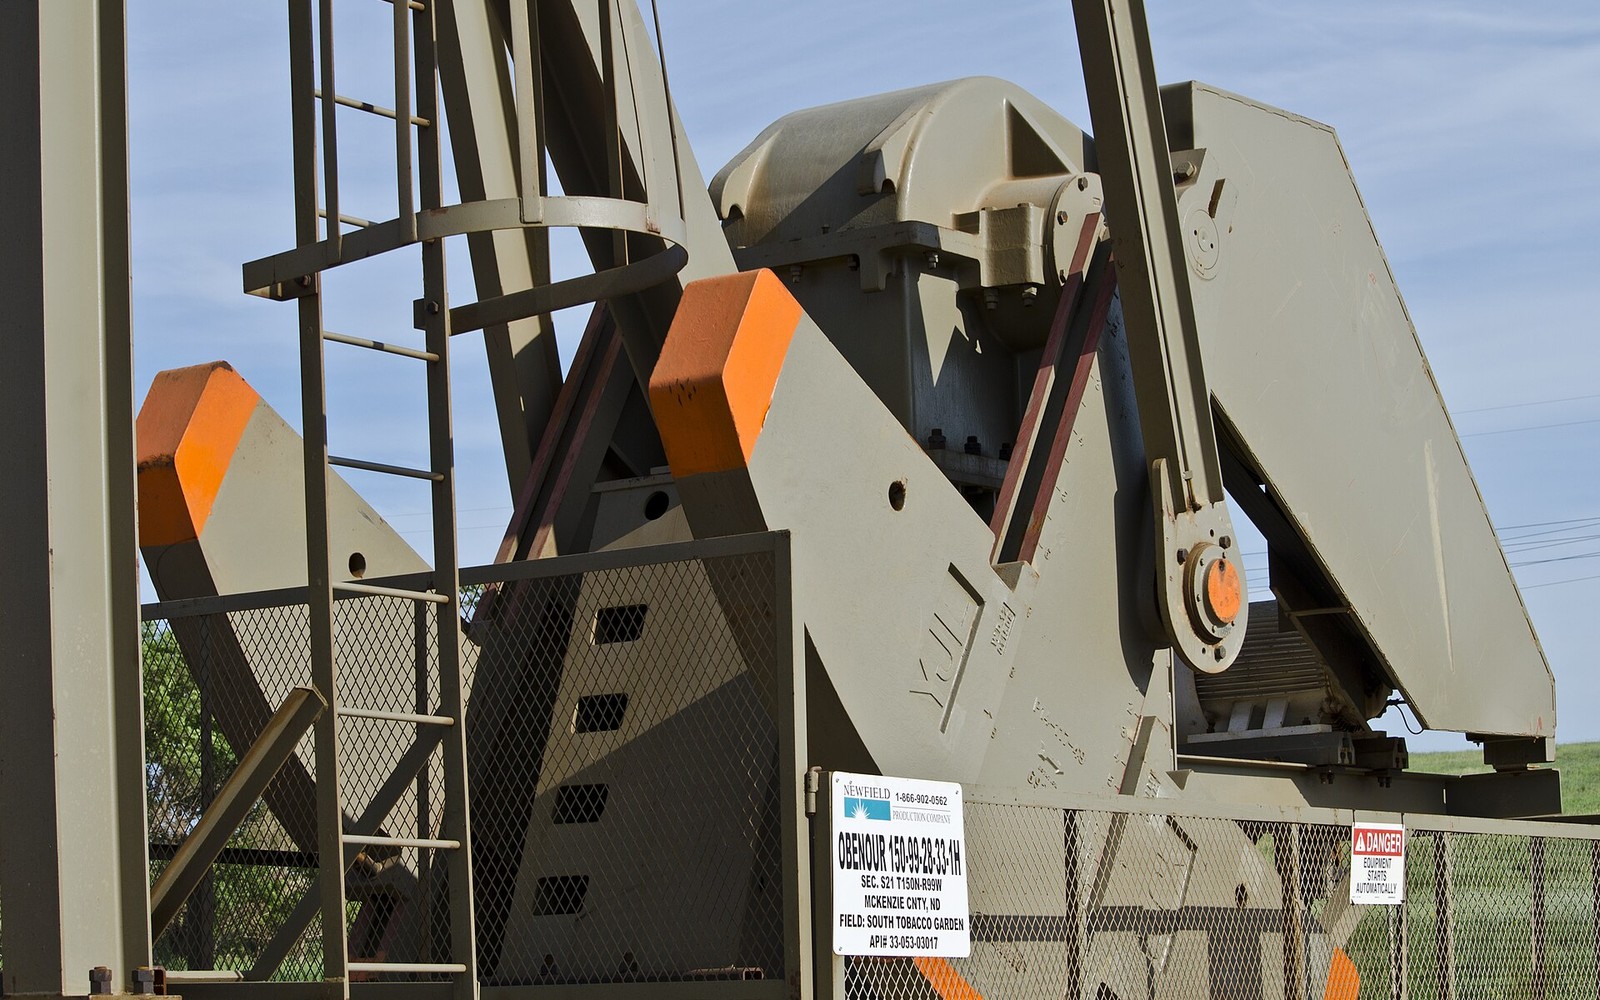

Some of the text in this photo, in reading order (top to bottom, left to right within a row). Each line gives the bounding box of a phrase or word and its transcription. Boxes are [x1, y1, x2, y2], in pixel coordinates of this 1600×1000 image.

[843, 784, 891, 800] NEWFIELD
[895, 792, 948, 806] 1-866-902-0562
[892, 810, 951, 824] PRODUCTION COMPANY
[1366, 832, 1402, 853] DANGER
[838, 831, 962, 876] OBENOUR 150-99-28-33-1H
[1363, 857, 1392, 869] EQUIPMENT
[1367, 869, 1387, 881] STARTS
[861, 874, 942, 892] SEC. S21 T150N-R99W
[1355, 882, 1397, 894] AUTOMATICALLY
[864, 894, 941, 913] MCKENZIE CNTY, ND
[839, 913, 964, 931] FIELD: SOUTH TOBACCO GARDEN
[869, 935, 938, 949] API# 33-053-03017
